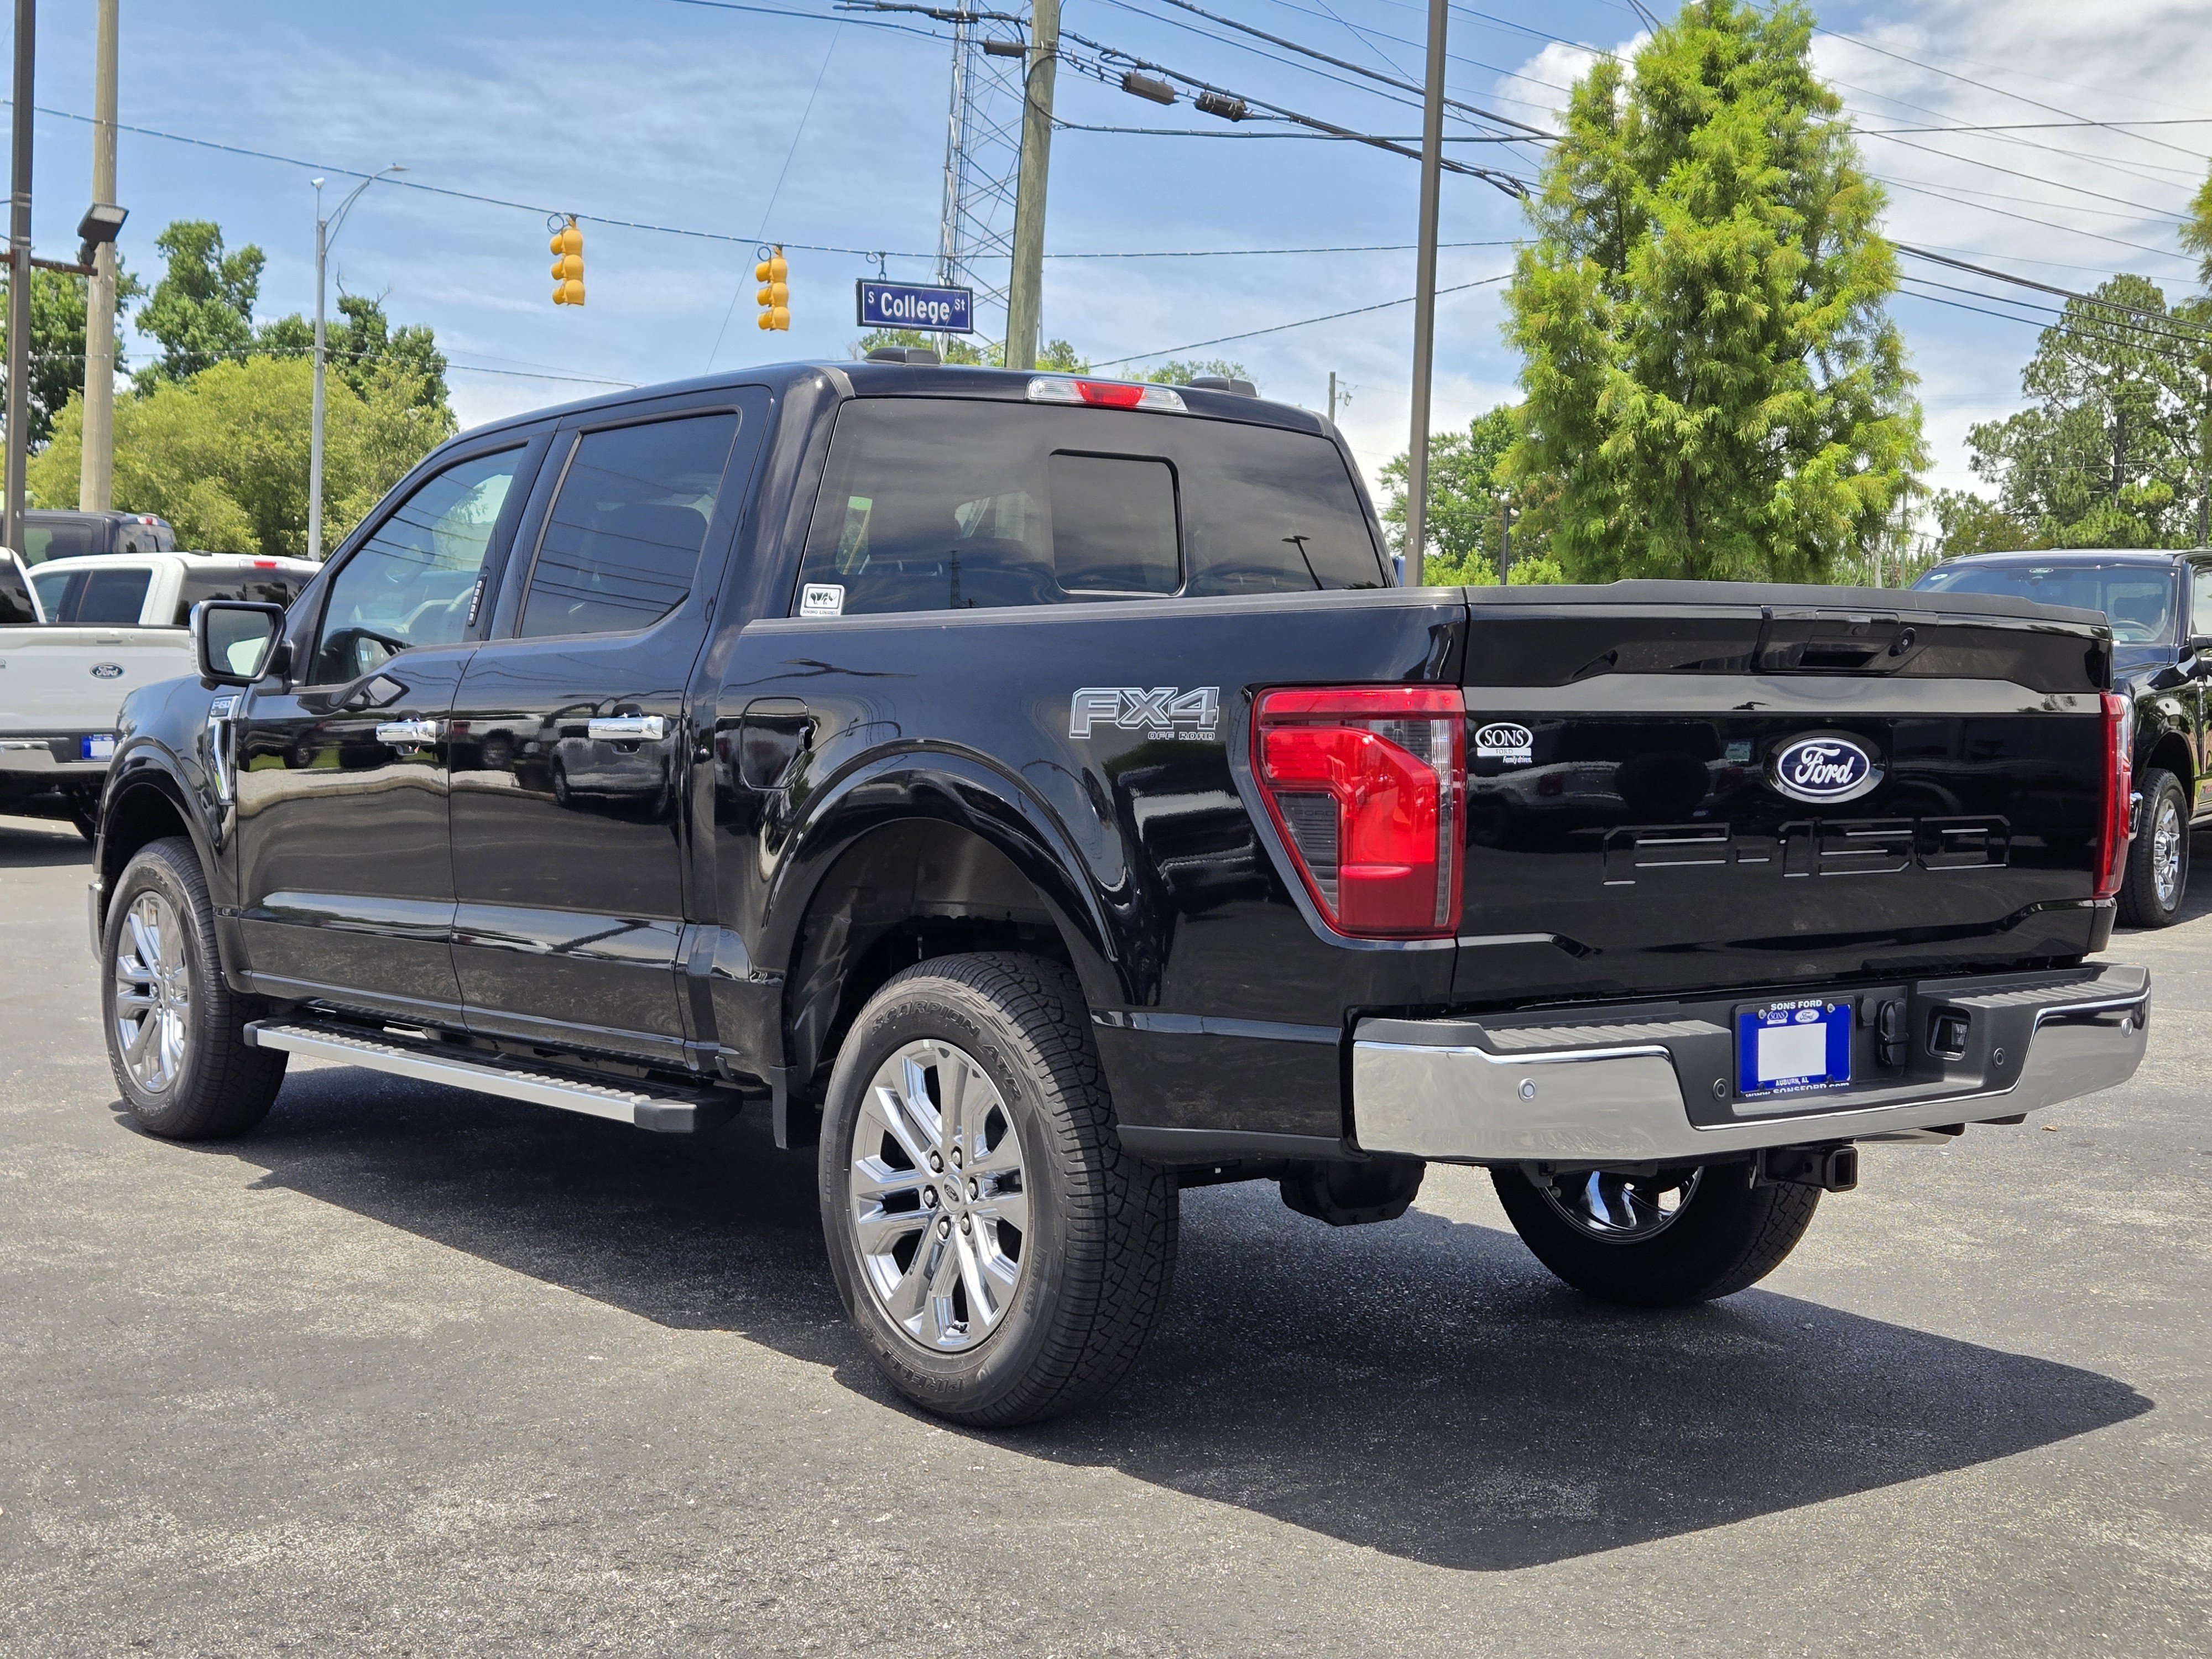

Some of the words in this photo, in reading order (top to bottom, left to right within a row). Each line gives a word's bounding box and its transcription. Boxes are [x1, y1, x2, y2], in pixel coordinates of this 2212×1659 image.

[868, 291, 874, 304] S
[881, 293, 950, 324] College
[954, 298, 965, 311] St
[96, 665, 118, 676] Ford
[1069, 686, 1219, 739] FX4
[1147, 731, 1175, 740] OFF
[1179, 732, 1215, 740] ROAD
[1484, 730, 1524, 746] SONS
[1795, 747, 1855, 784] Ford
[1771, 1002, 1796, 1010] SONS
[1798, 1000, 1822, 1008] FORD
[872, 1000, 981, 1036] SCORPION
[1800, 1011, 1814, 1020] Ford
[946, 1186, 957, 1200] Ford
[881, 1349, 963, 1393] PIRELLI
